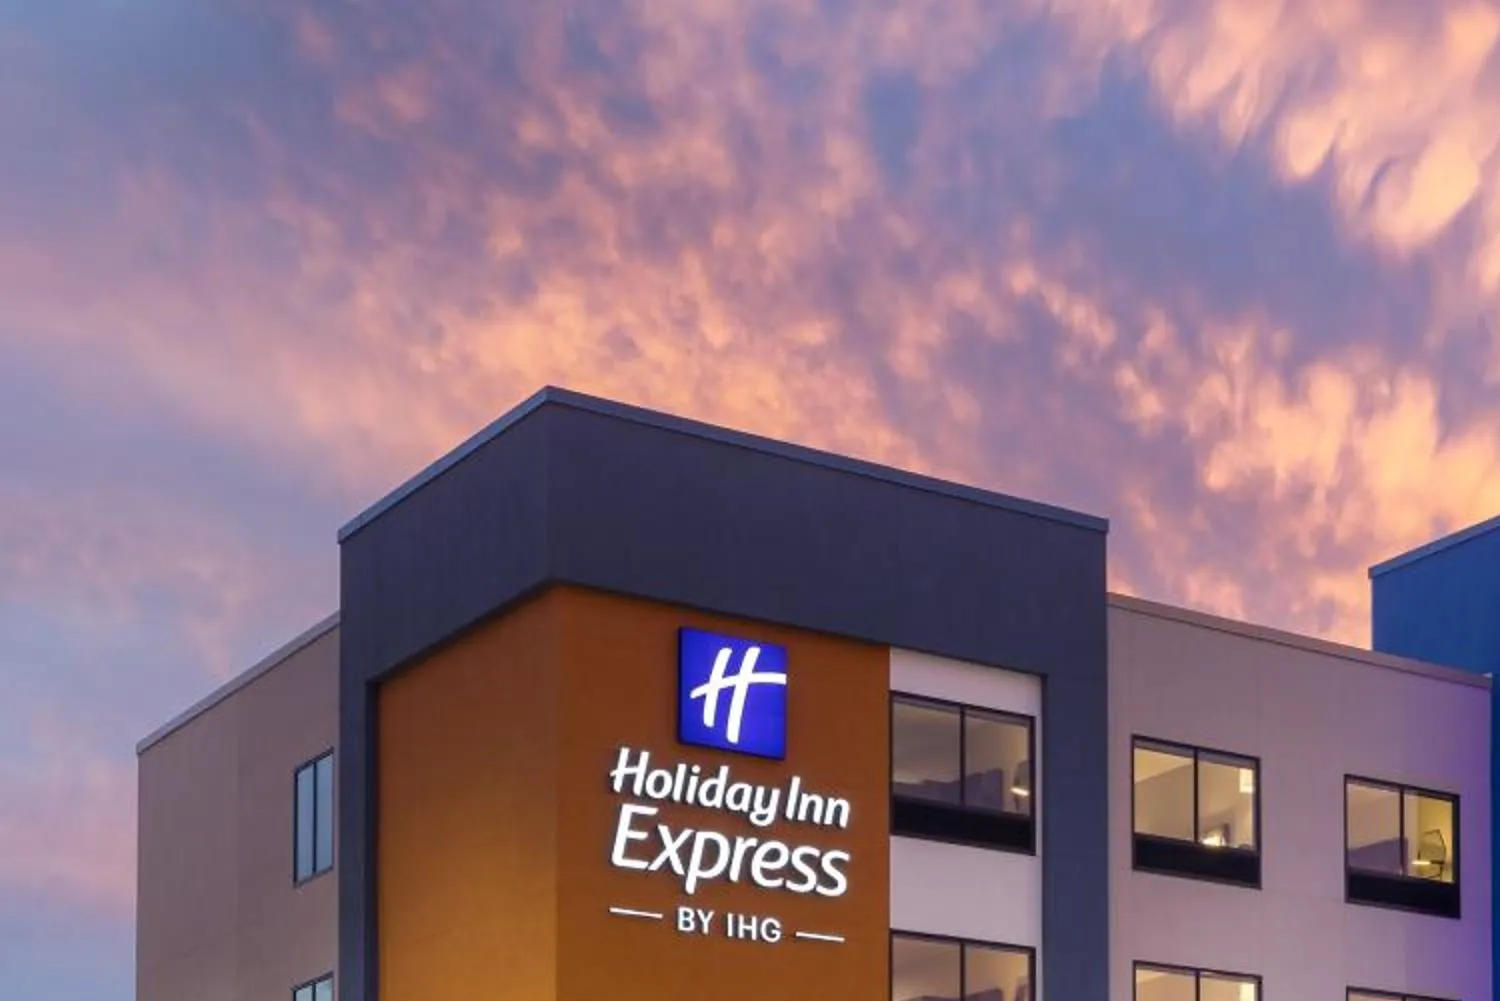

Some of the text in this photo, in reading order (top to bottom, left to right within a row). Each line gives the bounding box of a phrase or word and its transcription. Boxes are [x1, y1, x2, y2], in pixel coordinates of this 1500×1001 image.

[610, 747, 850, 828] Holiday Inn
[611, 803, 850, 896] Express
[677, 906, 783, 942] BY IHG
